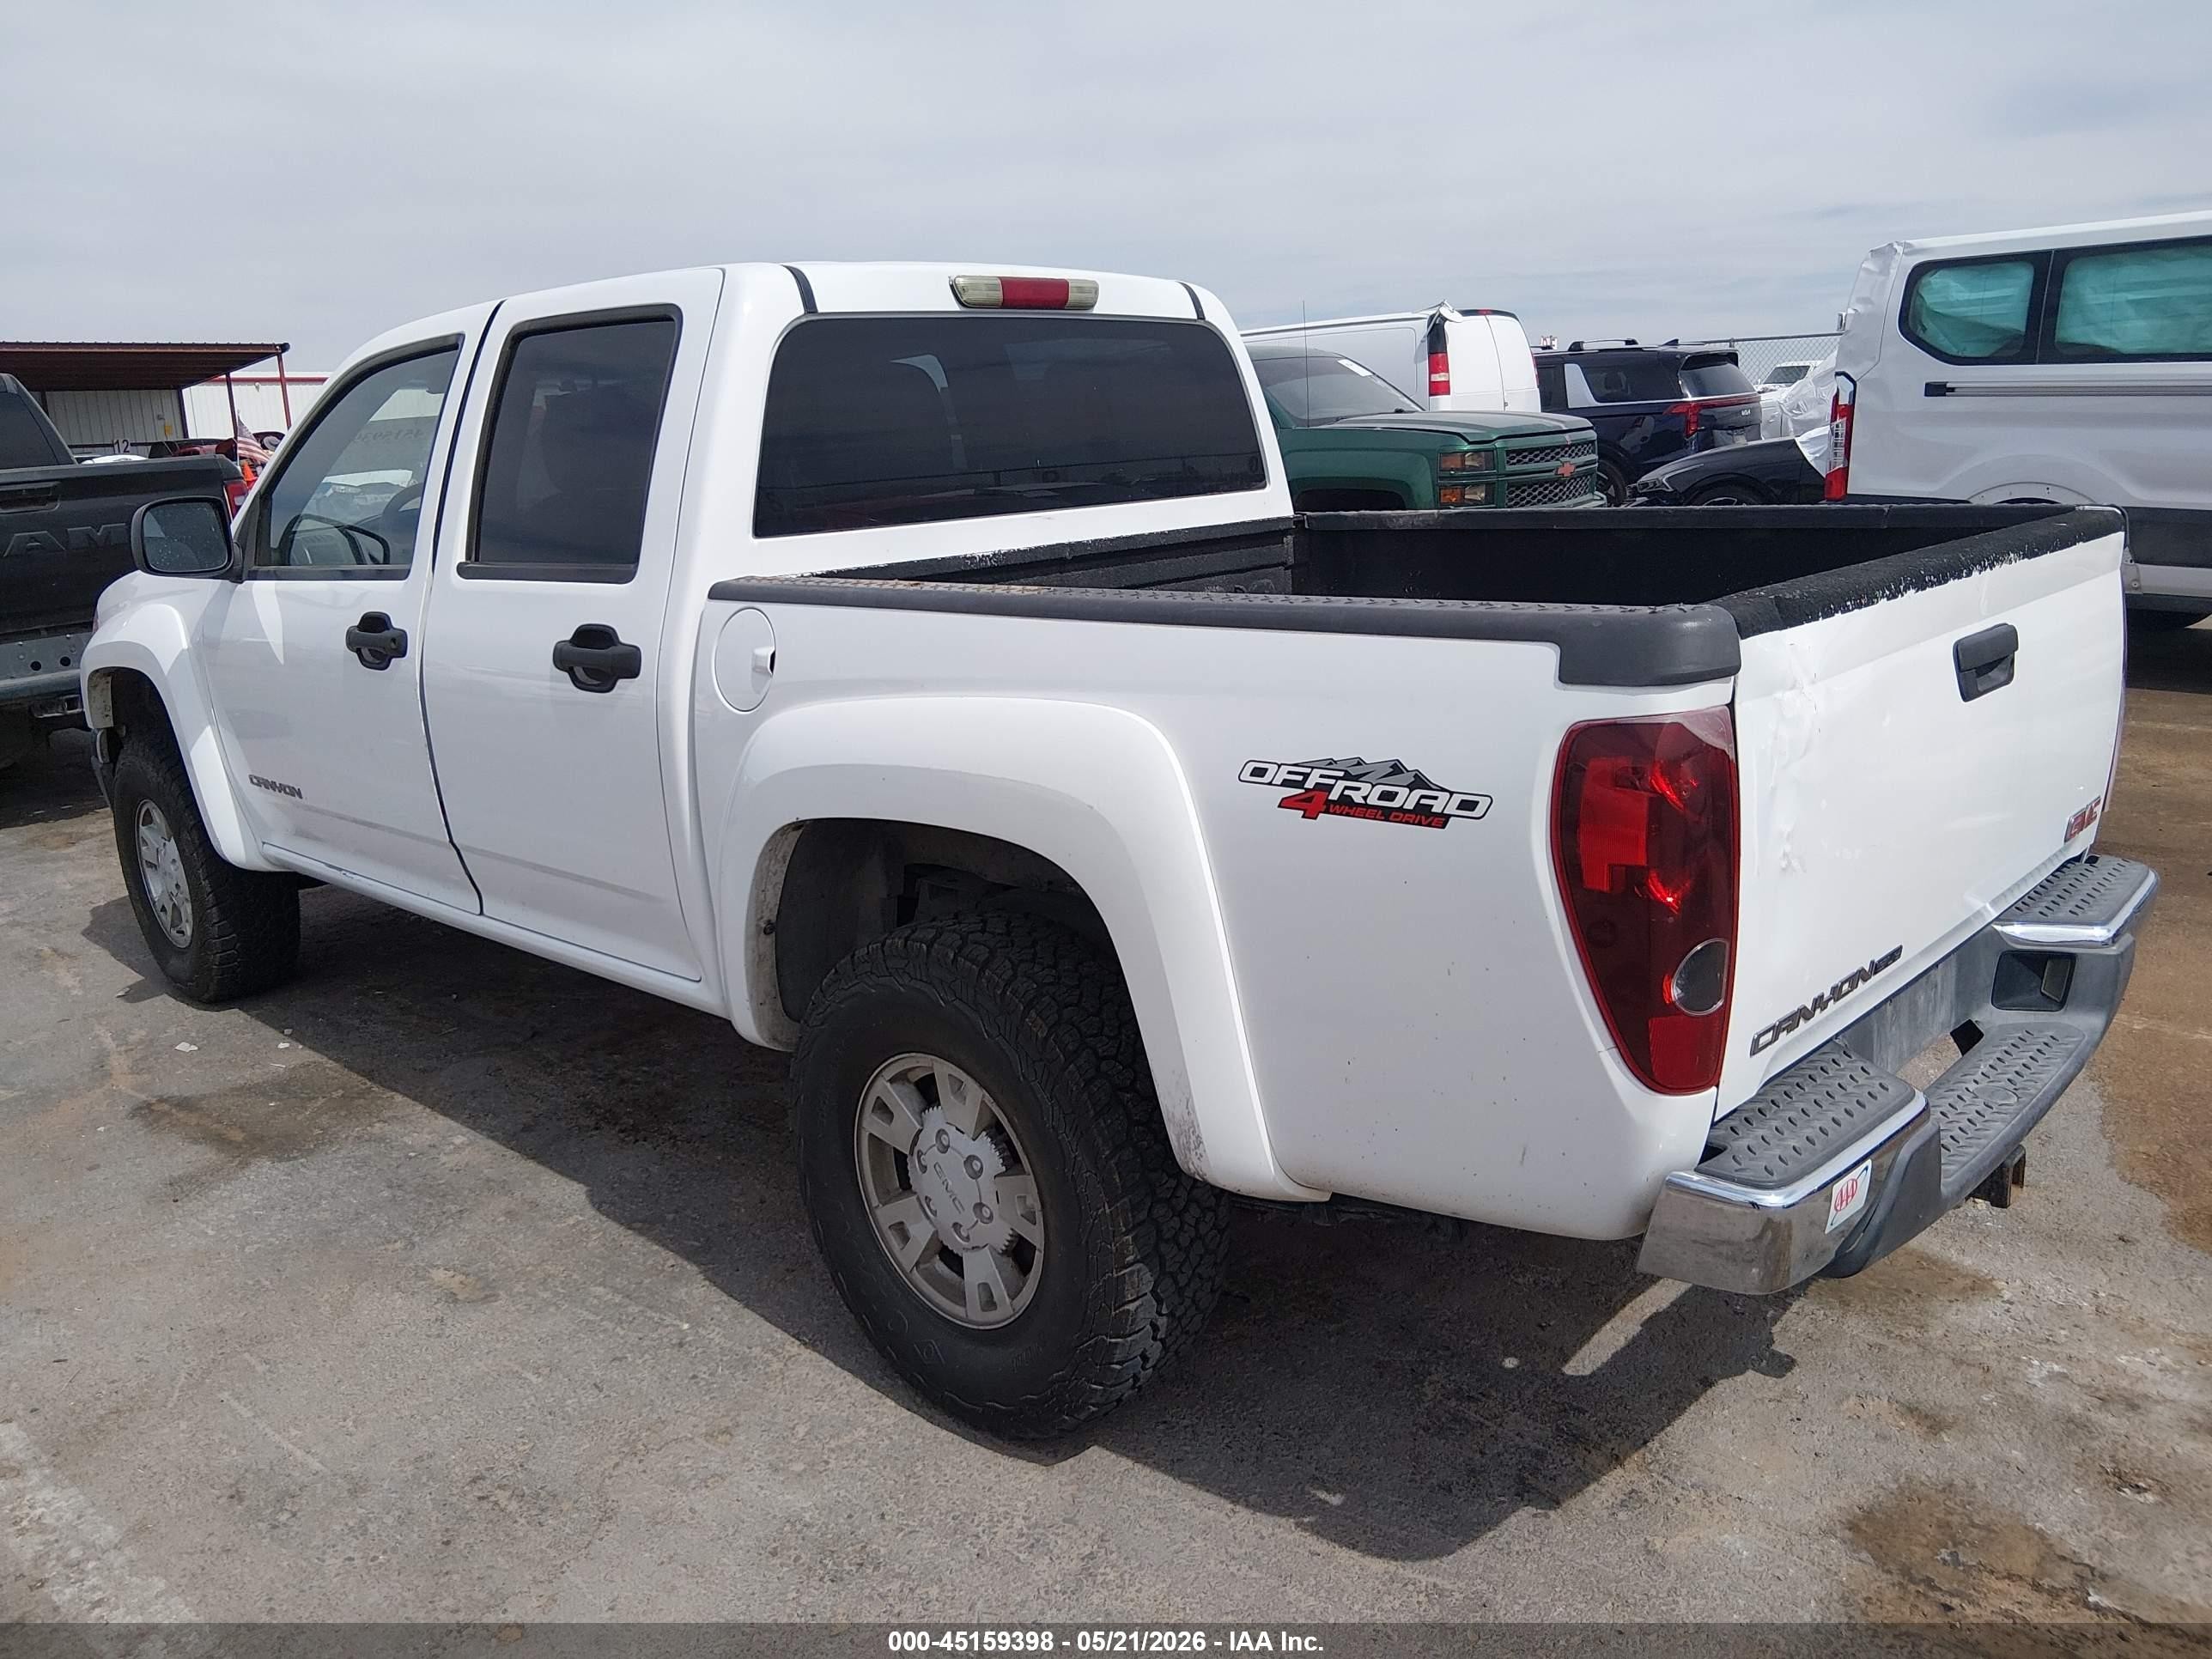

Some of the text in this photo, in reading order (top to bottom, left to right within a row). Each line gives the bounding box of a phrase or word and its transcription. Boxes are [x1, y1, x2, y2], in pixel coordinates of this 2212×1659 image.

[248, 774, 303, 799] CANYON
[1279, 790, 1448, 829] 4 WHEEL DRIVE
[1749, 959, 1876, 1058] CANYON
[933, 1161, 965, 1214] GMC
[1835, 1179, 1857, 1212] AAA
